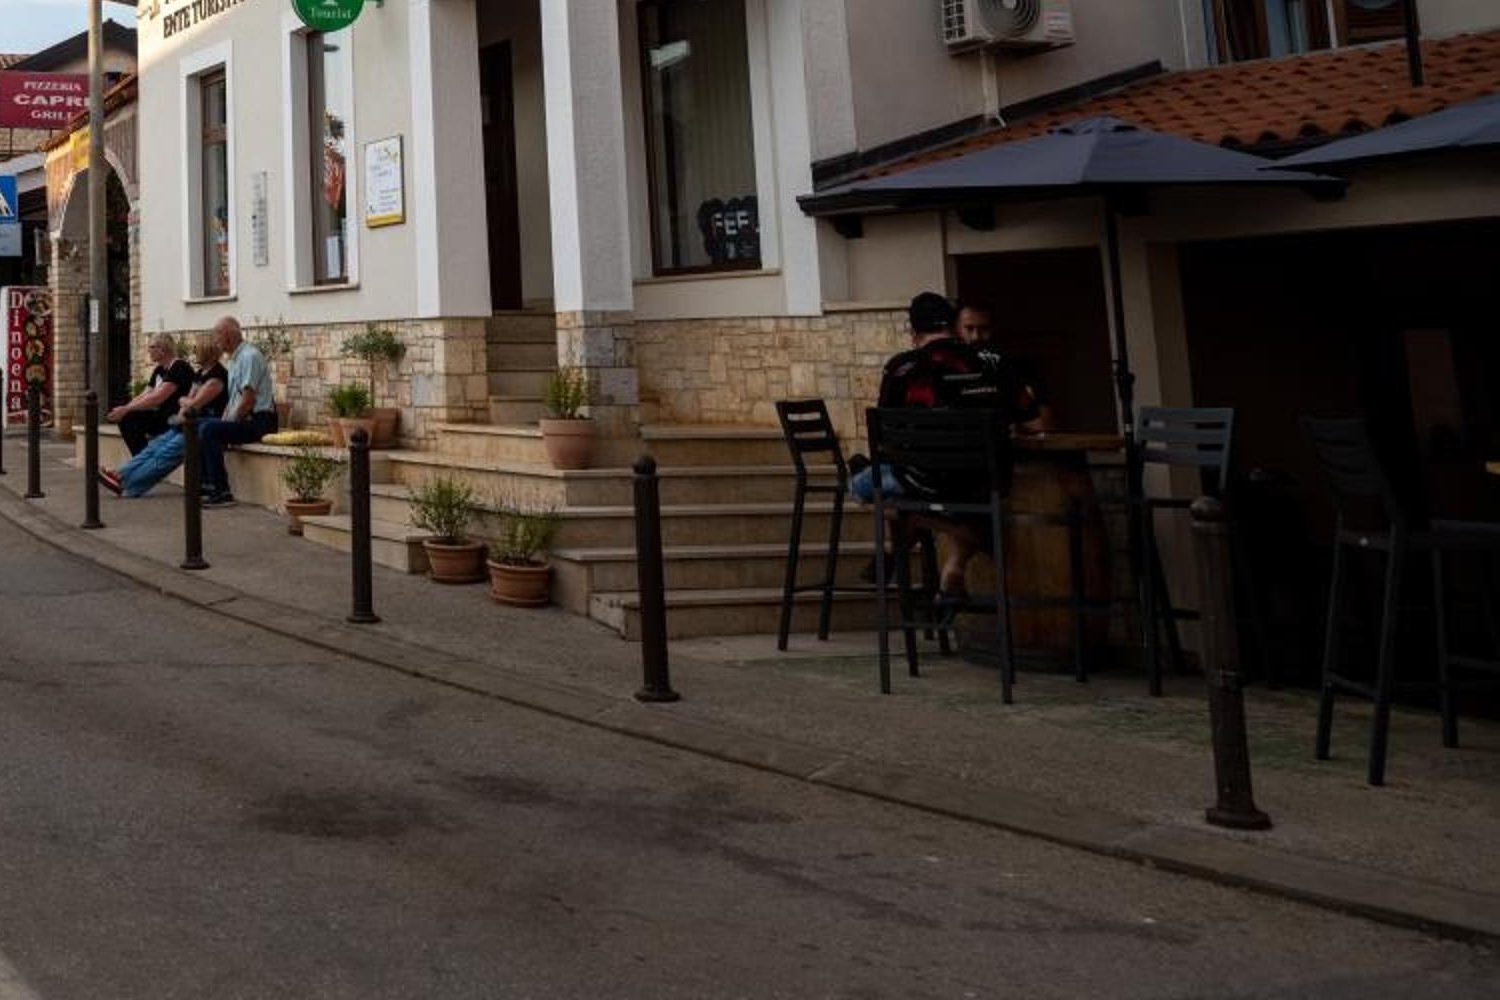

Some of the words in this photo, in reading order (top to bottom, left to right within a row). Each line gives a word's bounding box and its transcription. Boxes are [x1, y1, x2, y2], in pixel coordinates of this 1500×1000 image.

[310, 7, 352, 19] Tourist
[163, 4, 191, 39] ENTE
[23, 81, 82, 91] PIZZERIA
